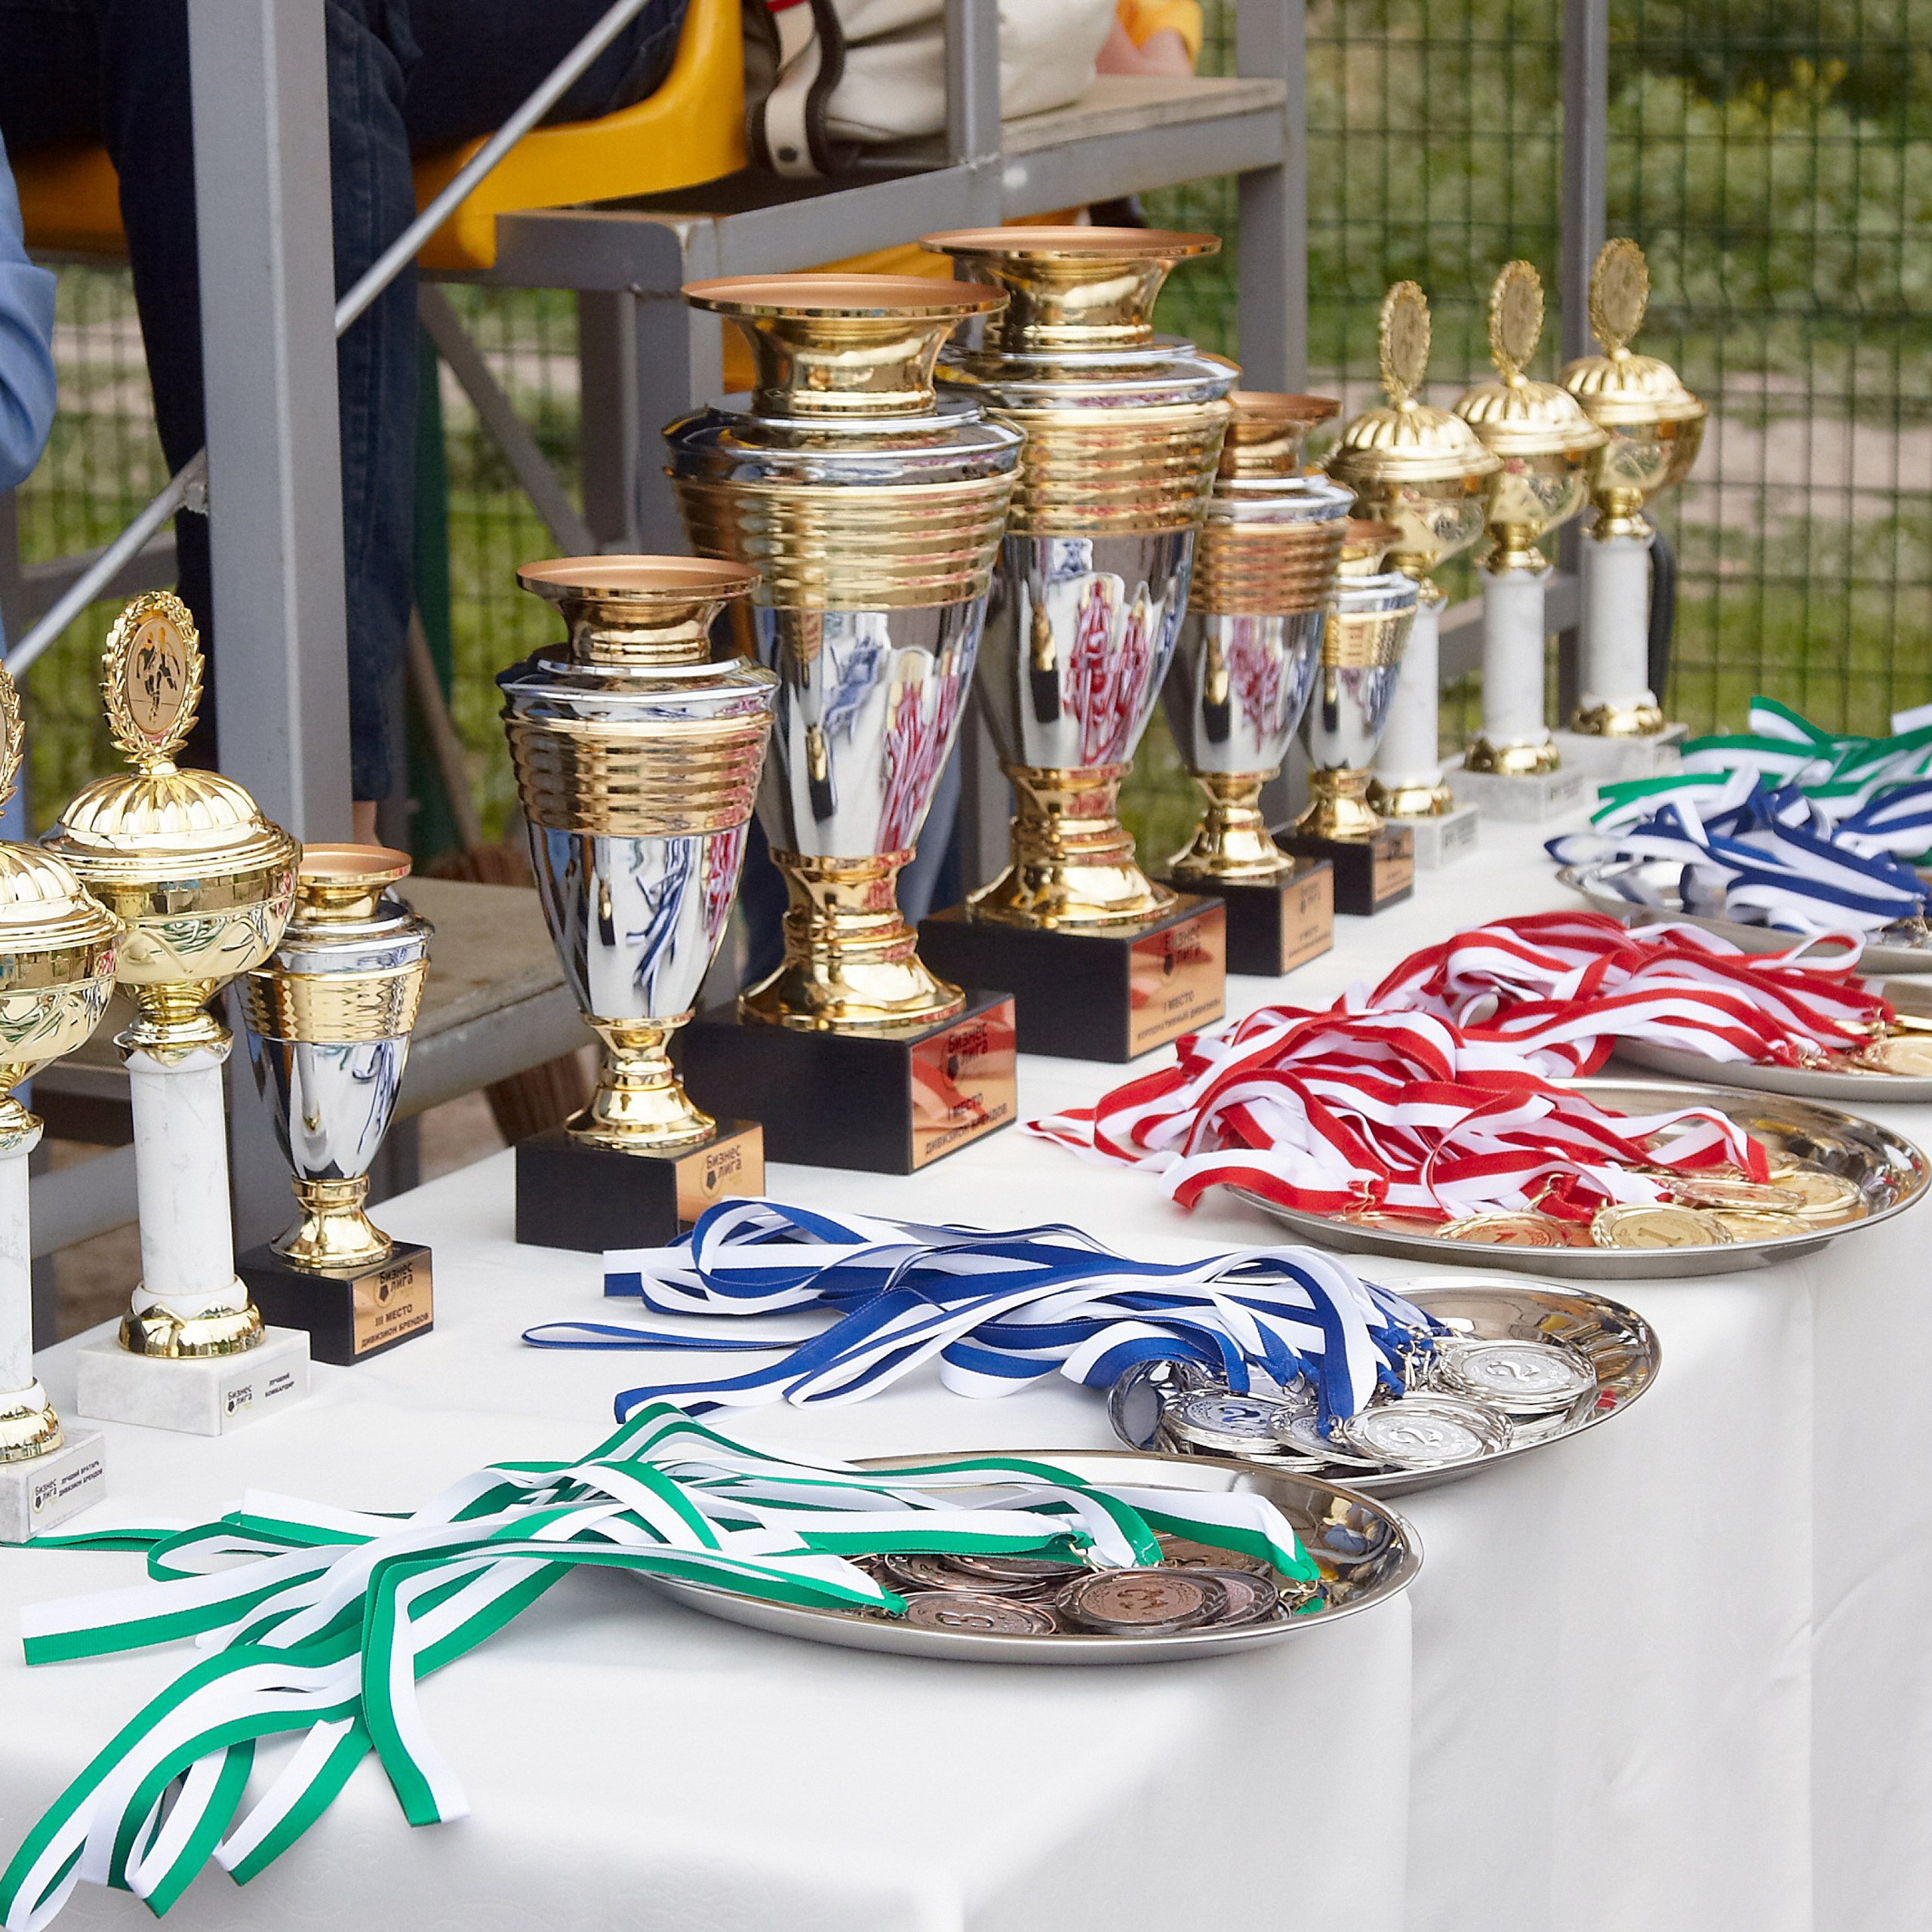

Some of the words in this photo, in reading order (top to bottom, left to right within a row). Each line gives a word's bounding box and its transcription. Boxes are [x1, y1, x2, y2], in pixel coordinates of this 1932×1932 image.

[386, 1303, 413, 1322] МЕСТО
[361, 1325, 397, 1349] ДИВИЗИОН
[398, 1312, 429, 1331] БРЕНДОВ
